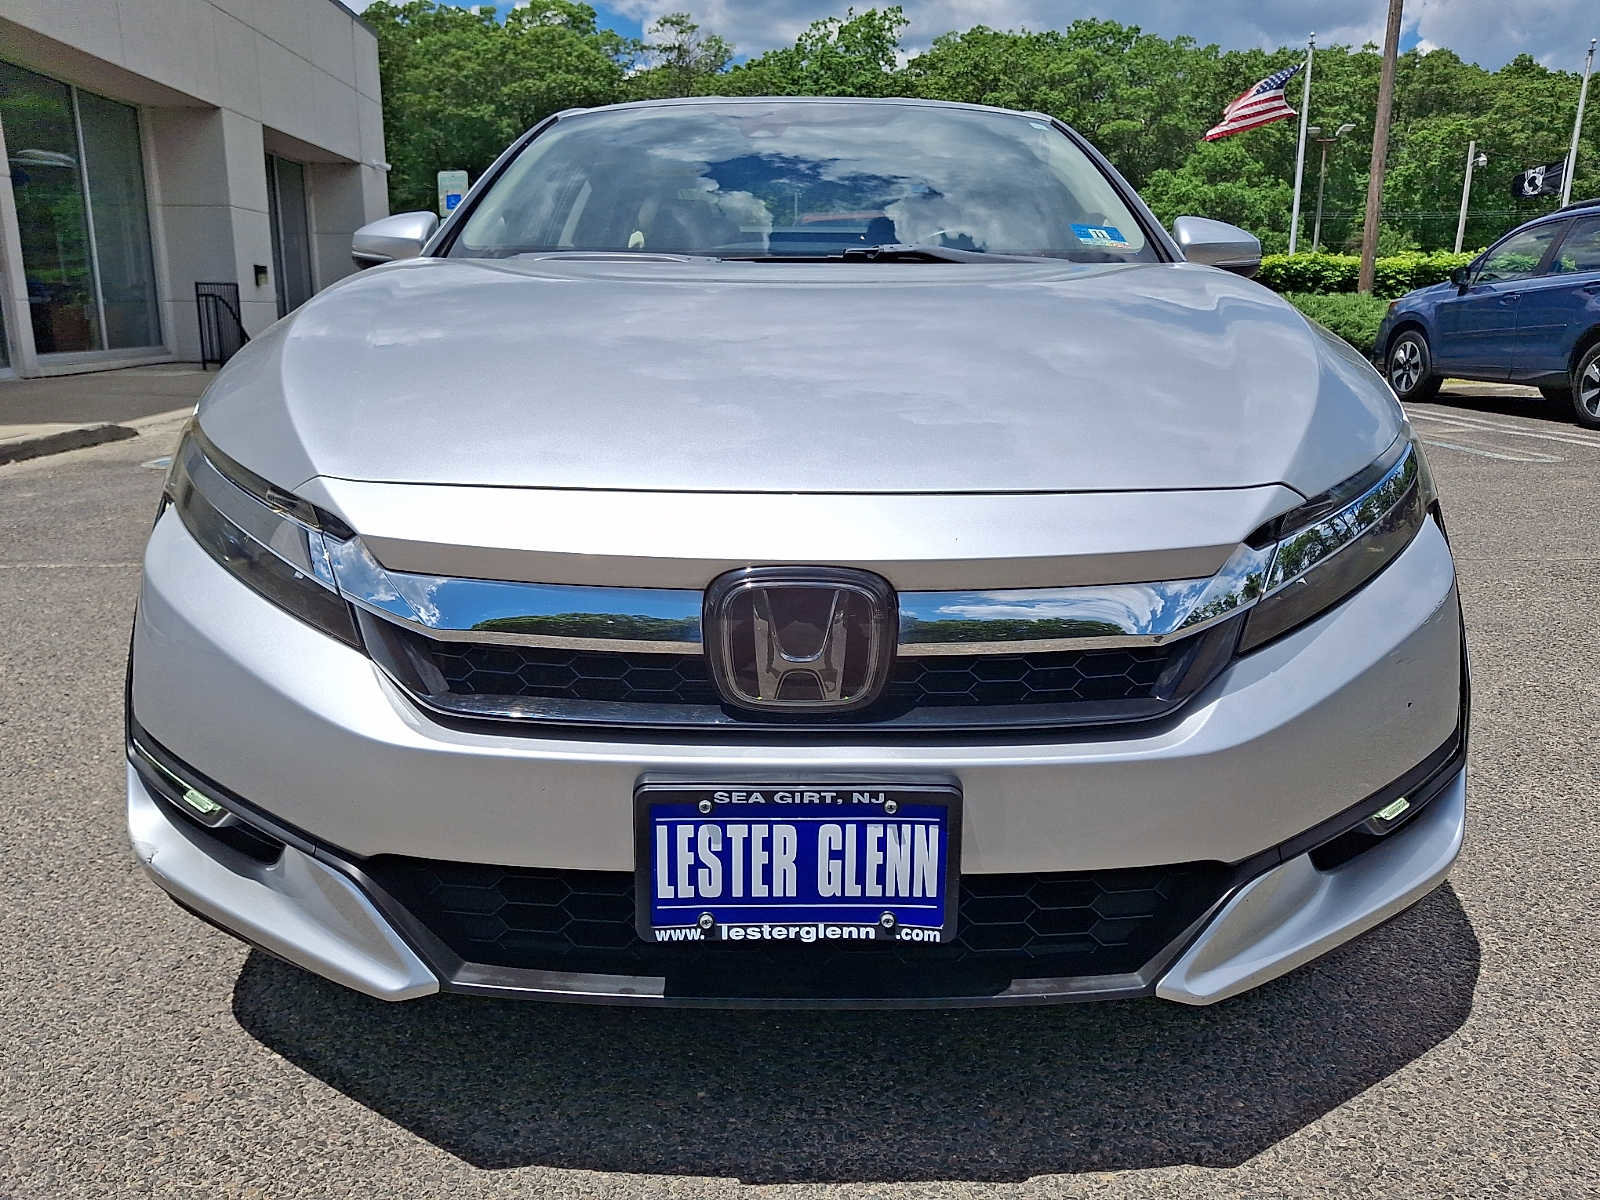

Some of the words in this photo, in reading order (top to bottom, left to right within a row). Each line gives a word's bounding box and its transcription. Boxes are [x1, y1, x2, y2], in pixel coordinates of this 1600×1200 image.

[713, 791, 766, 804] SEA
[773, 791, 843, 806] GIRT,
[852, 792, 886, 804] NJ
[655, 823, 798, 899] LESTER
[817, 823, 940, 898] GLENN
[720, 923, 876, 943] lesterglenn
